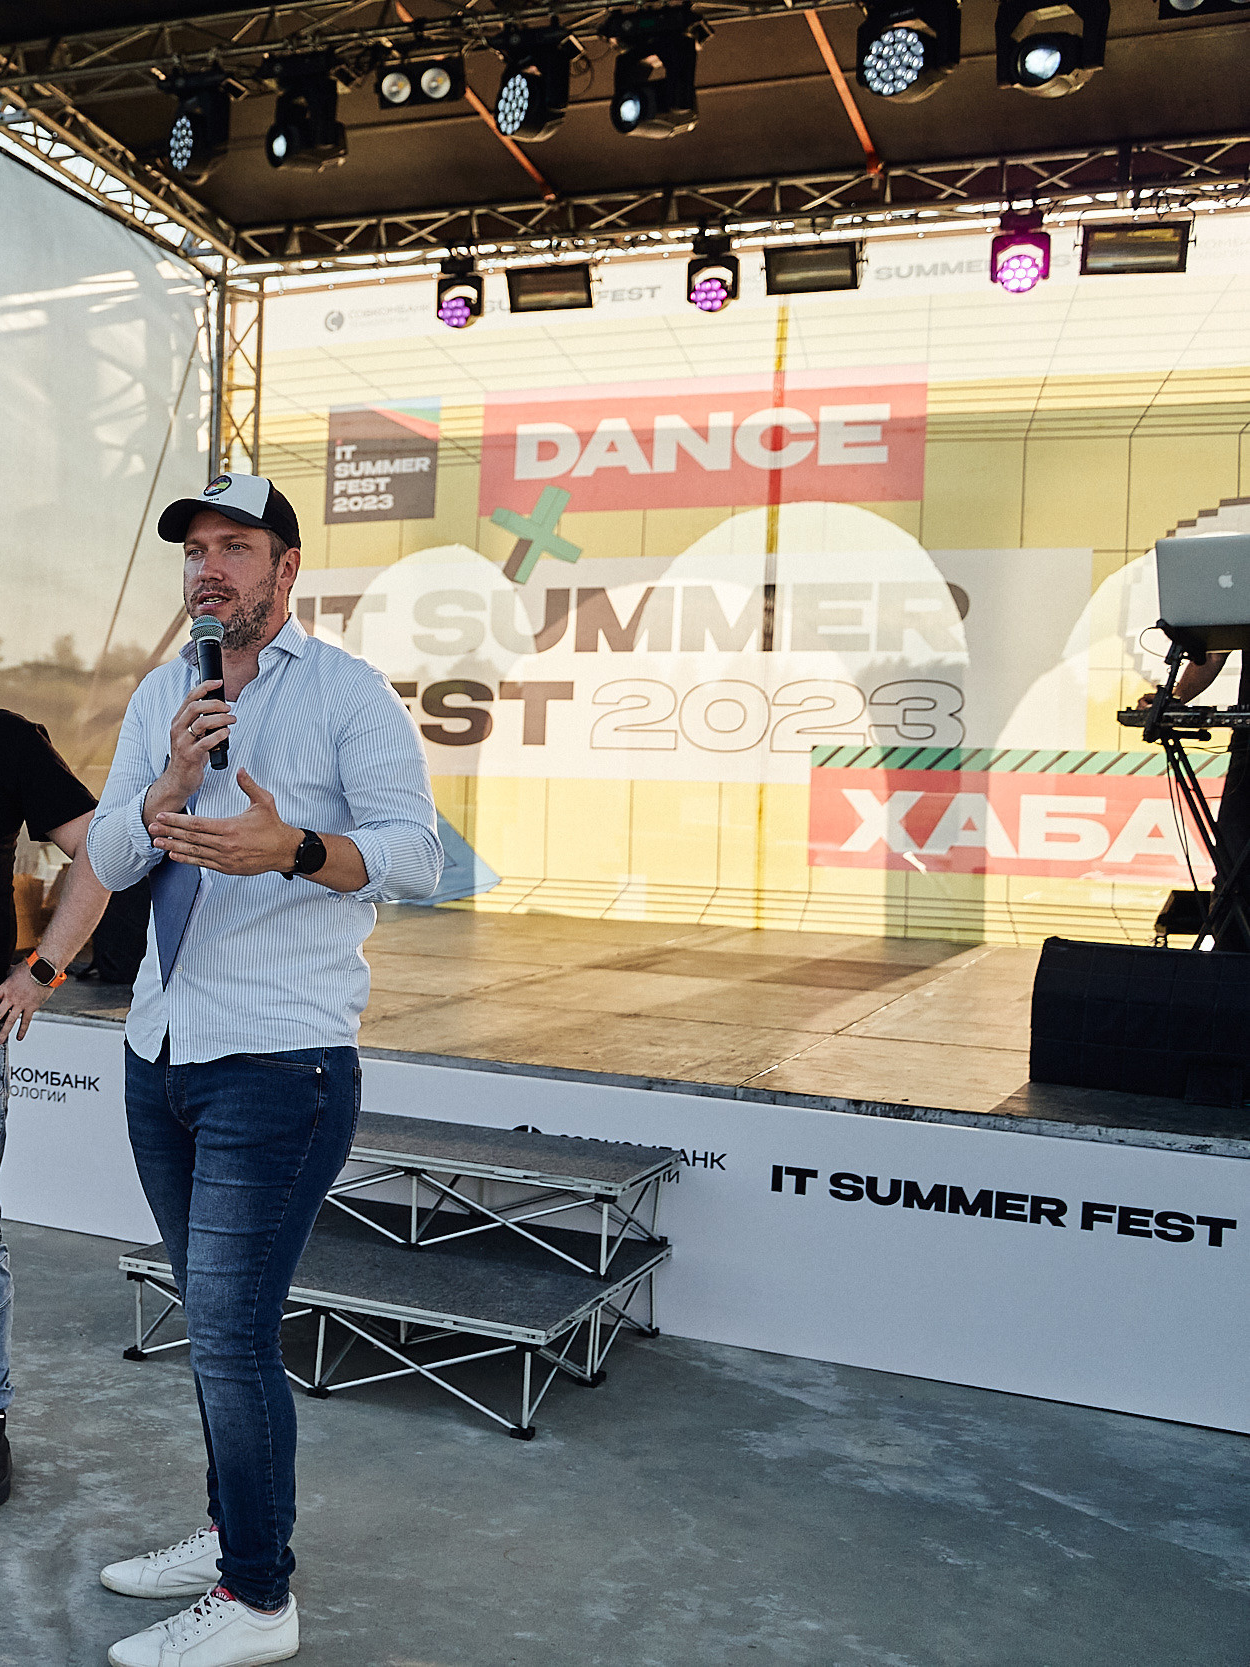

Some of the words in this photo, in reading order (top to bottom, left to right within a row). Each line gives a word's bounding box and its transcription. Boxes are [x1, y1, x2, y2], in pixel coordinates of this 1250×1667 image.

[874, 257, 990, 281] SUMME
[335, 446, 355, 461] IT
[513, 403, 891, 481] DANCE
[334, 457, 431, 477] SUMMER
[333, 476, 389, 495] FEST
[332, 494, 394, 513] 2023
[297, 593, 386, 656] IT
[413, 581, 970, 654] SUMMER
[392, 680, 574, 747] ST
[589, 678, 967, 753] 2023
[840, 789, 1219, 864] ХАБА
[10, 1066, 100, 1092] КОМБАНК
[10, 1084, 67, 1103] ОЛОГИИ
[771, 1164, 819, 1196] IT
[828, 1171, 1067, 1228] SUMMER
[1080, 1201, 1237, 1248] FEST
